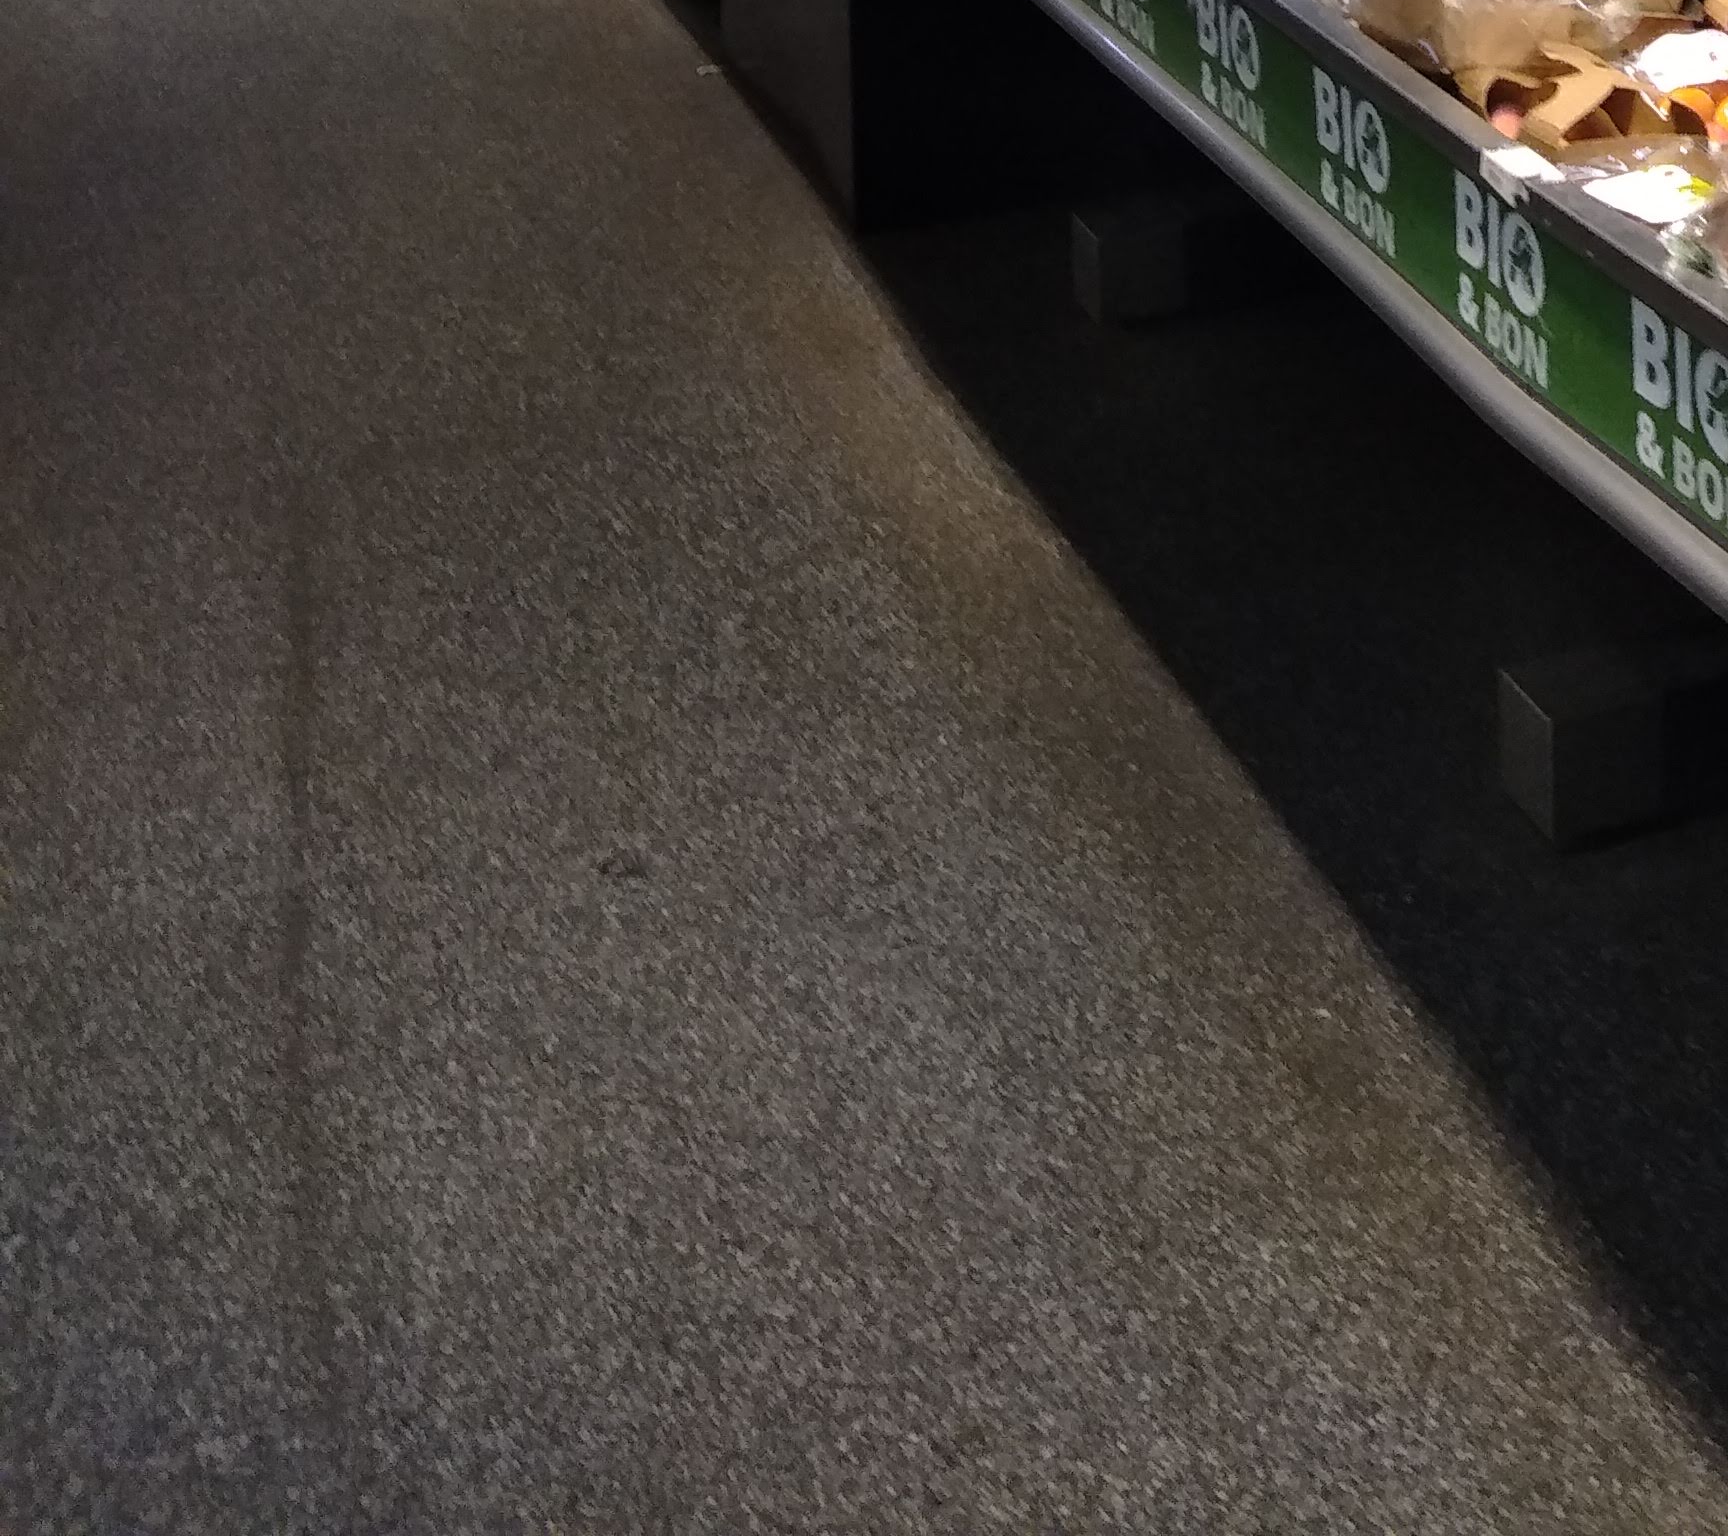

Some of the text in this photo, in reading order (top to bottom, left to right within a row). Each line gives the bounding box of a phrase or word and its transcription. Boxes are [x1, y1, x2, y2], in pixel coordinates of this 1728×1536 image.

[1312, 65, 1390, 194] BIO
[1342, 173, 1396, 259] BON
[1454, 169, 1545, 318] BIO
[1484, 294, 1549, 390] BON
[1635, 410, 1666, 480] &
